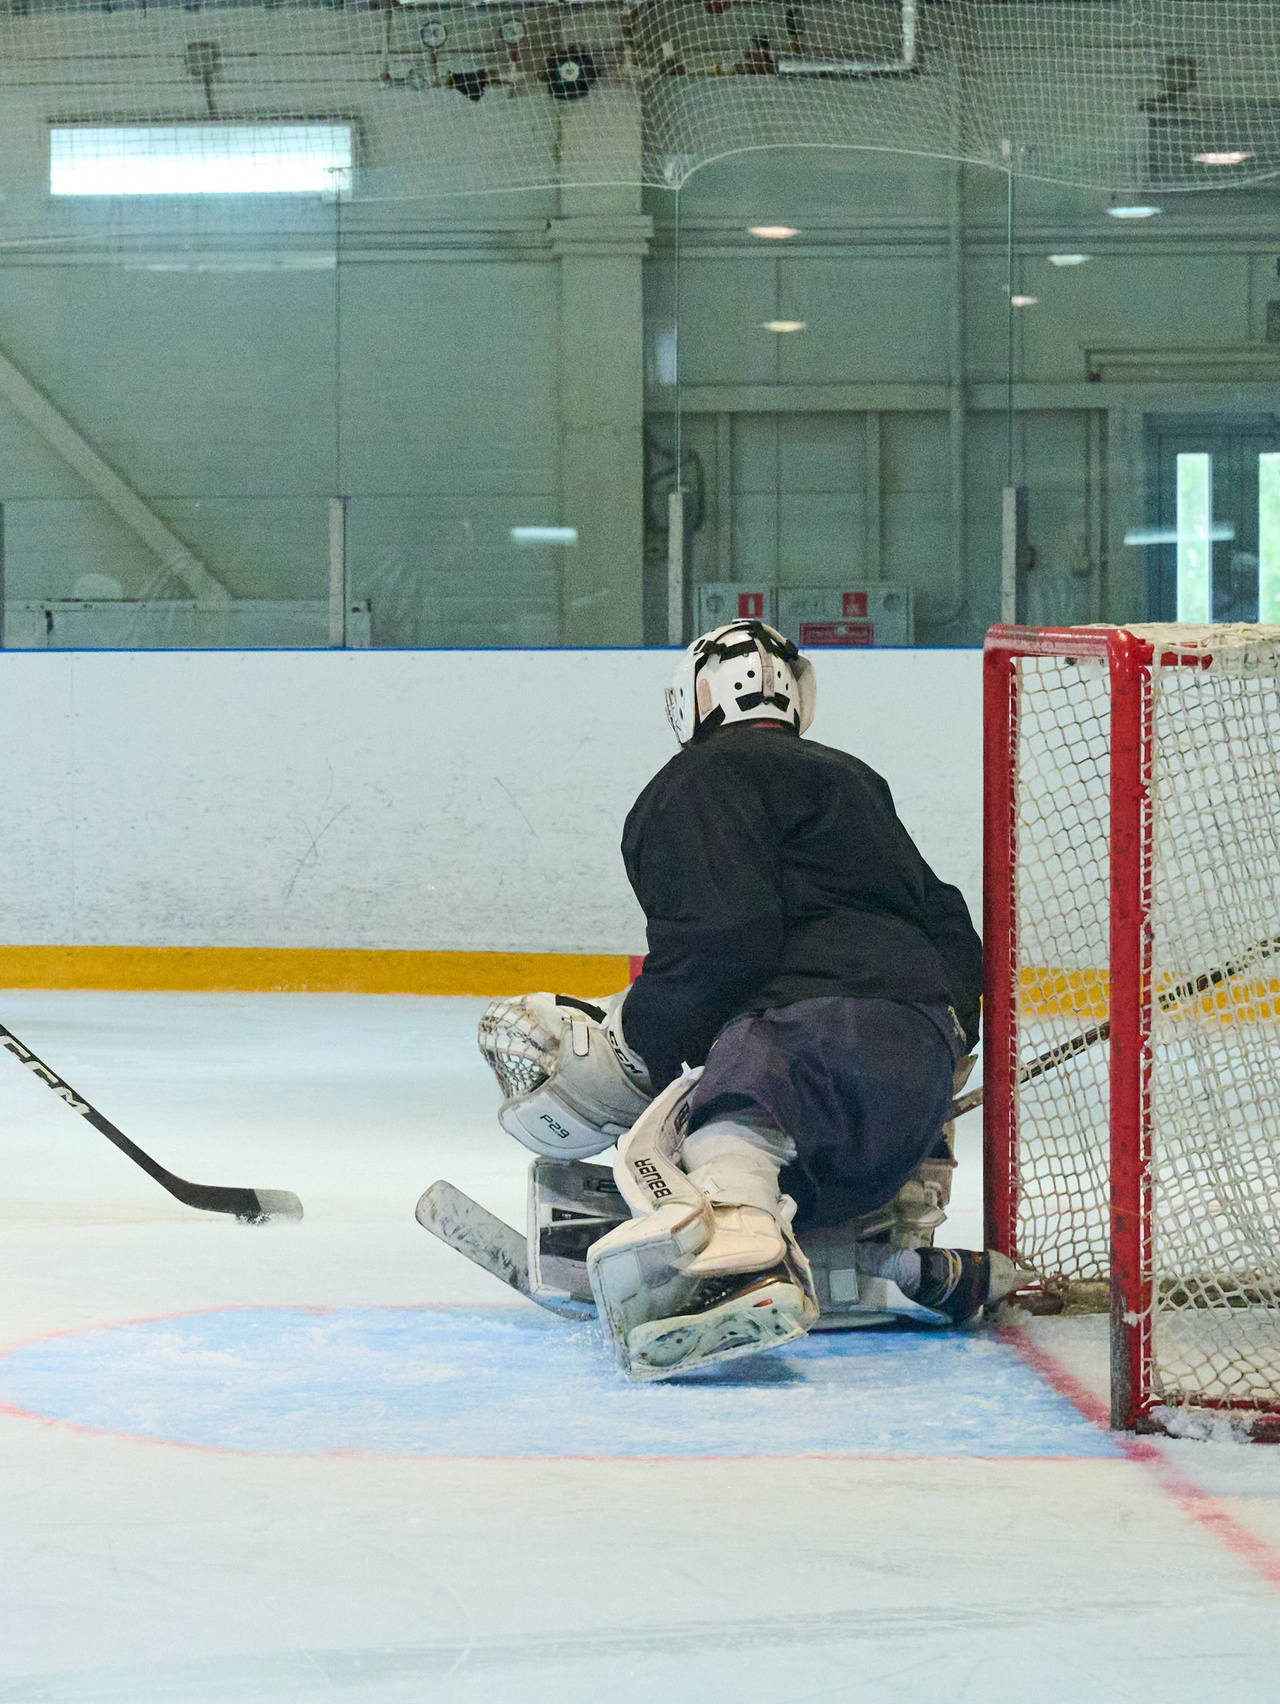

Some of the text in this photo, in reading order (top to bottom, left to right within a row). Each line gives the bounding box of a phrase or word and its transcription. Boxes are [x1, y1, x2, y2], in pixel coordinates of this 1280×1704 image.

[609, 1030, 643, 1074] CCM
[539, 1114, 570, 1139] P29
[634, 1157, 672, 1199] BAUER
